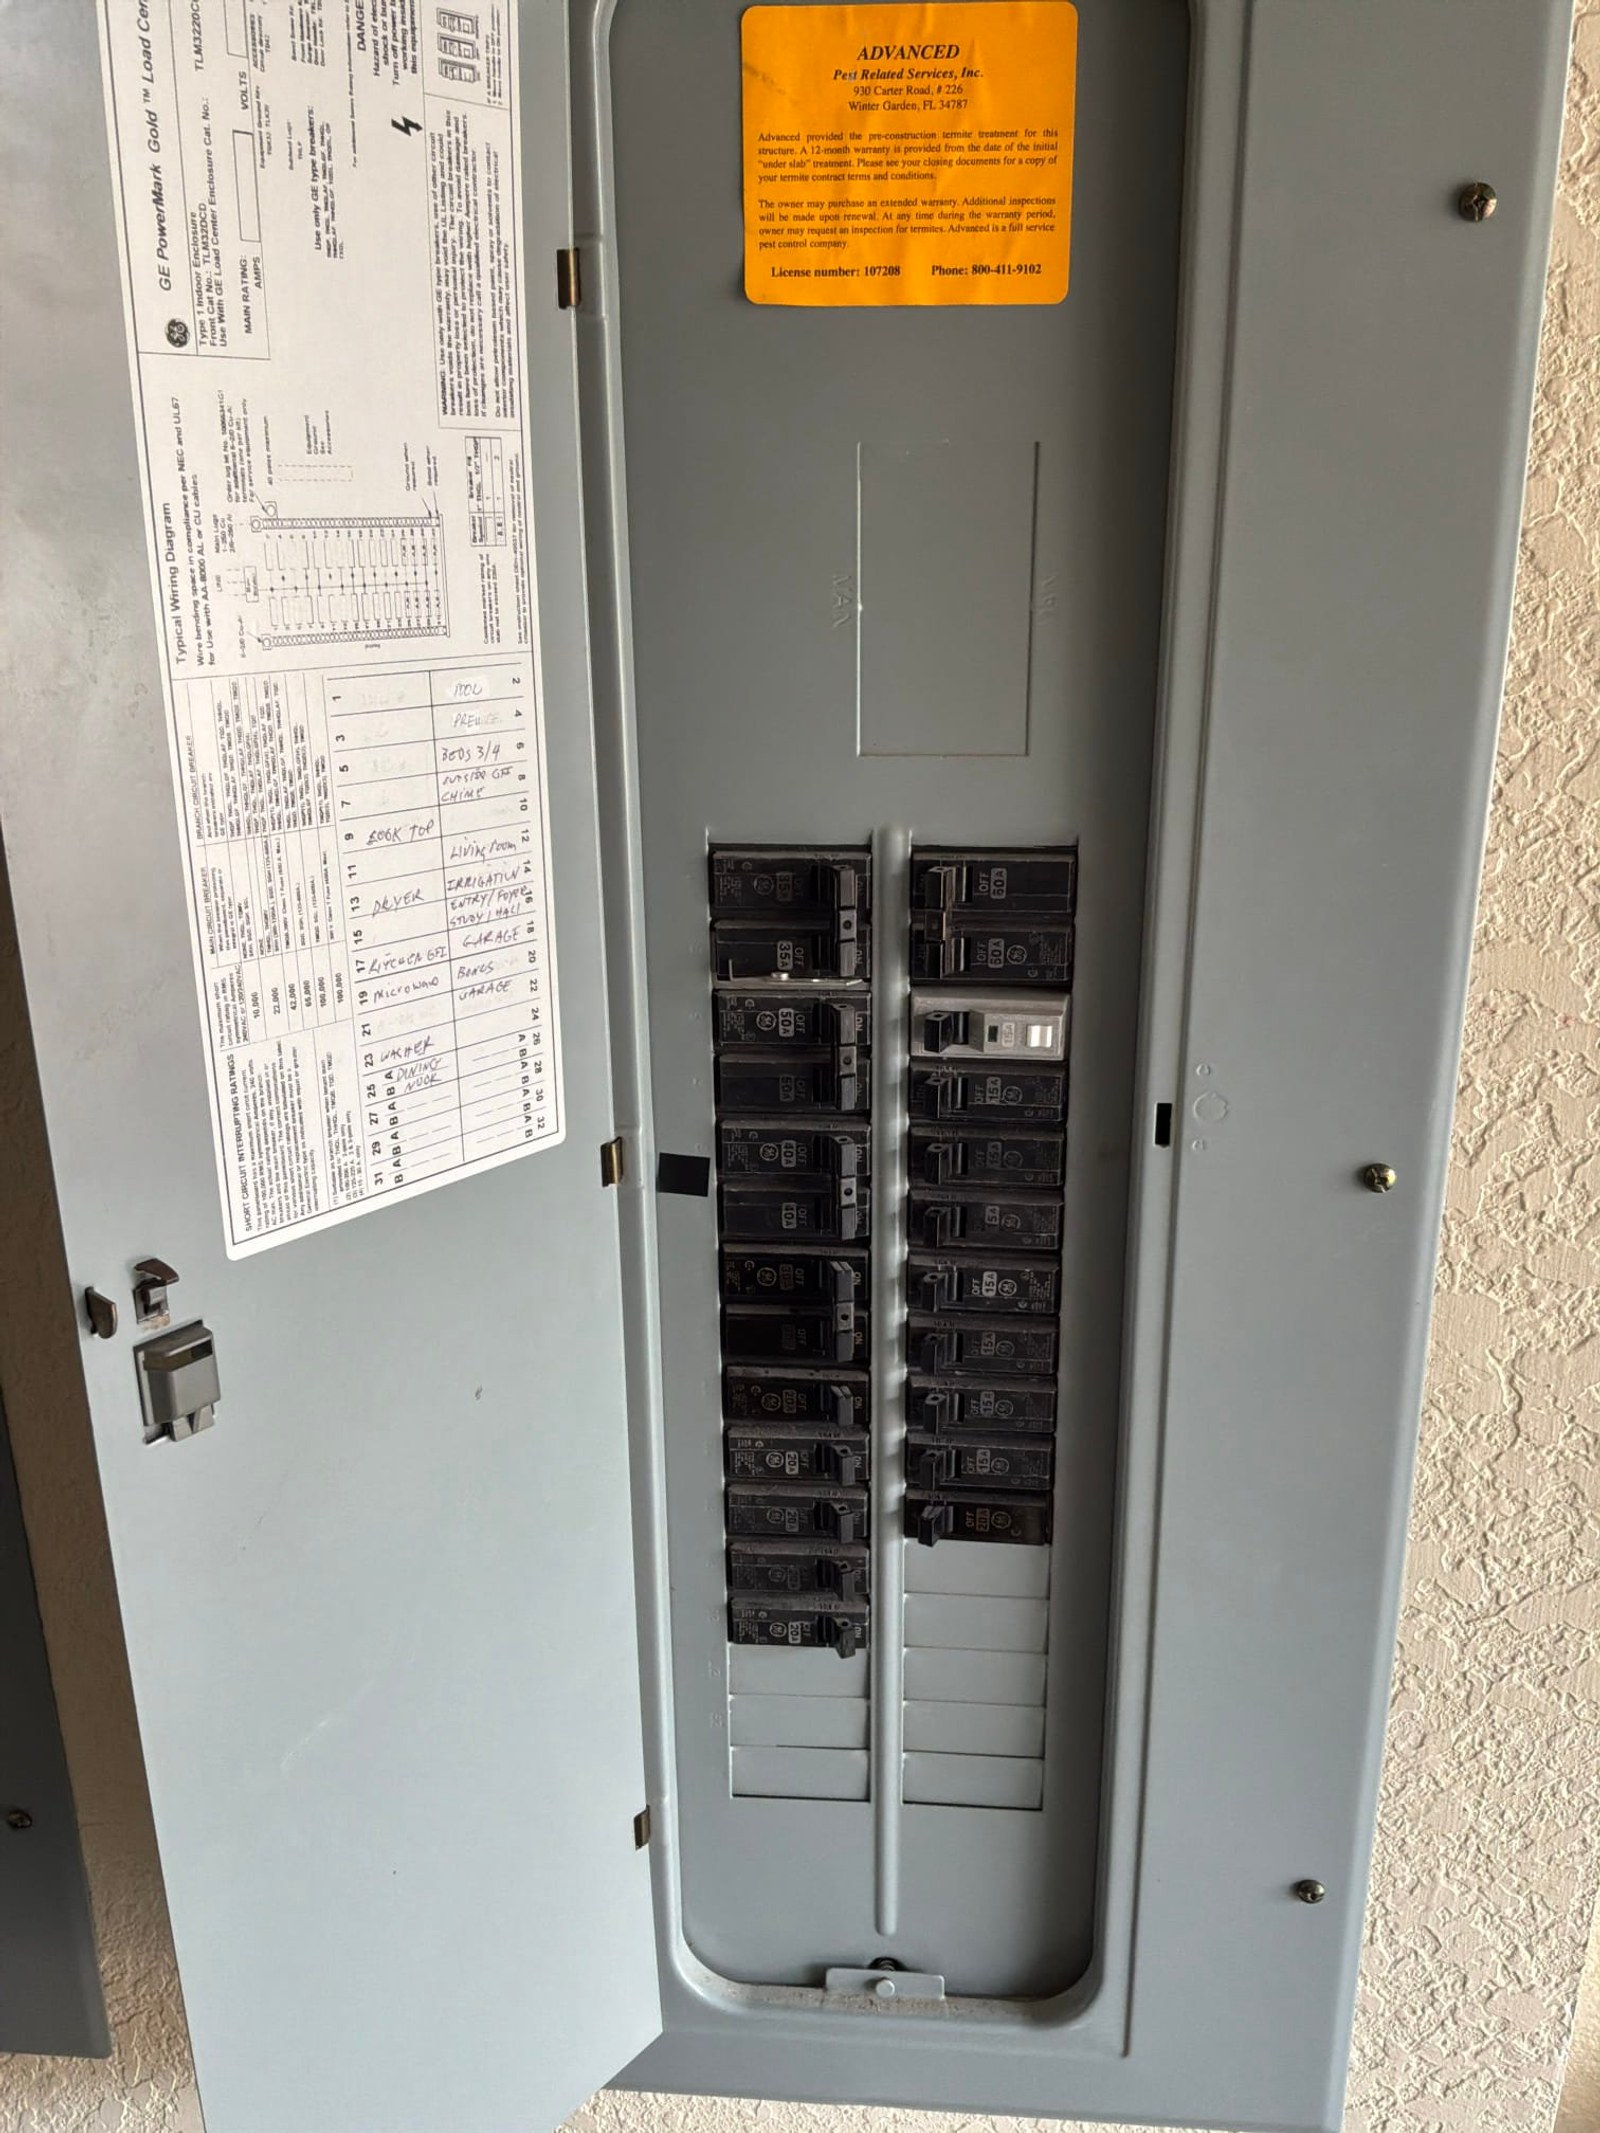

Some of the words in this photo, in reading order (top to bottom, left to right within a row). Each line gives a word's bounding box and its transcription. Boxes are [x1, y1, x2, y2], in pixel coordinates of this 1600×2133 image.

[190, 0, 204, 72] TLM3220C
[138, 35, 154, 84] Load
[856, 44, 960, 61] ADVANCED
[832, 69, 858, 80] Pest
[859, 67, 904, 81] Related
[906, 67, 958, 81] Services,
[960, 66, 983, 78] Inc.
[238, 71, 249, 110] VOLTS
[853, 85, 872, 97] 930
[873, 85, 904, 96] Carter
[905, 84, 934, 96] Road,
[936, 84, 943, 95] #
[944, 84, 964, 95] 226
[848, 100, 880, 111] Winter
[882, 99, 920, 112] Garden,
[922, 99, 936, 111] FL
[938, 98, 968, 110] 34787
[144, 108, 161, 153] Gold
[307, 106, 316, 156] breakers:
[757, 131, 800, 142] Advanced
[806, 131, 846, 144] provided
[849, 131, 863, 140] the
[868, 129, 939, 143] pre-construction
[942, 129, 973, 139] termite
[977, 129, 1019, 139] treatment
[1024, 128, 1037, 138] for
[1042, 127, 1058, 137] this
[758, 147, 797, 156] structure.
[799, 145, 808, 156] A
[811, 144, 851, 155] 12-month
[853, 145, 891, 156] warranty
[893, 145, 901, 154] is
[903, 143, 941, 156] provided
[944, 143, 965, 153] from
[967, 142, 981, 152] the
[983, 142, 1002, 155] date
[1004, 142, 1015, 152] of
[1016, 142, 1030, 151] the
[1033, 141, 1058, 151] initial
[205, 148, 216, 205] Enclosure
[310, 158, 320, 182] type
[757, 172, 778, 185] your
[779, 172, 809, 182] termite
[811, 173, 845, 182] contract
[847, 172, 871, 181] terms
[873, 171, 889, 181] and
[310, 185, 319, 202] GE
[757, 198, 775, 209] The
[777, 200, 804, 209] owner
[806, 200, 825, 211] may
[827, 198, 865, 210] purchase
[879, 197, 918, 208] extended
[961, 196, 1006, 210] Additional
[1008, 196, 1056, 208] inspections
[149, 163, 169, 261] PowerMark
[312, 203, 321, 228] only
[209, 208, 219, 246] Center
[190, 211, 201, 268] Enclosure
[314, 229, 322, 250] Use
[211, 247, 222, 276] Load
[252, 256, 262, 289] AMPS
[771, 266, 811, 278] License
[814, 265, 860, 277] number:
[864, 265, 900, 277] 107208
[931, 264, 968, 276] Phone:
[971, 263, 1042, 275] 800-411-9102
[157, 264, 172, 291] GE
[194, 270, 204, 307] Indoor
[214, 279, 223, 296] GE
[239, 255, 250, 302] RATING:
[206, 295, 215, 315] Cat
[216, 299, 226, 324] With
[242, 304, 252, 334] MAIN
[198, 319, 209, 346] Type
[208, 317, 217, 347] Front
[218, 326, 227, 347] Use
[174, 426, 183, 446] and
[175, 448, 185, 472] NEC
[180, 474, 189, 492] per
[190, 474, 200, 507] cables
[162, 502, 176, 562] Diagram
[182, 493, 193, 553] compliance
[196, 528, 203, 539] or
[188, 555, 194, 565] in
[196, 541, 205, 556] AL
[167, 566, 181, 612] Wiring
[189, 567, 199, 597] space
[192, 599, 202, 640] bending
[203, 603, 212, 627] with
[171, 615, 187, 664] Typical
[206, 629, 214, 649] Use
[196, 642, 205, 666] Wire
[207, 651, 216, 666] for
[477, 740, 501, 763] 3/4
[350, 896, 360, 912] 13
[372, 888, 425, 918] DRYER
[462, 925, 521, 948] GARAGE
[356, 960, 366, 973] 17
[528, 950, 537, 964] 20
[779, 943, 792, 969] 35A
[358, 990, 369, 1005] 19
[459, 980, 513, 1001] GARAGE
[530, 979, 539, 993] 22
[250, 991, 260, 1019] 10,000
[780, 1010, 793, 1036] 50A
[364, 1053, 374, 1068] 23
[226, 1053, 238, 1095] RATINGS
[231, 1095, 245, 1163] INTERRUPTING
[238, 1164, 249, 1200] CIRCUIT
[242, 1202, 252, 1231] SHORT
[984, 1273, 997, 1296] 15A
[787, 1453, 799, 1474] 20A
